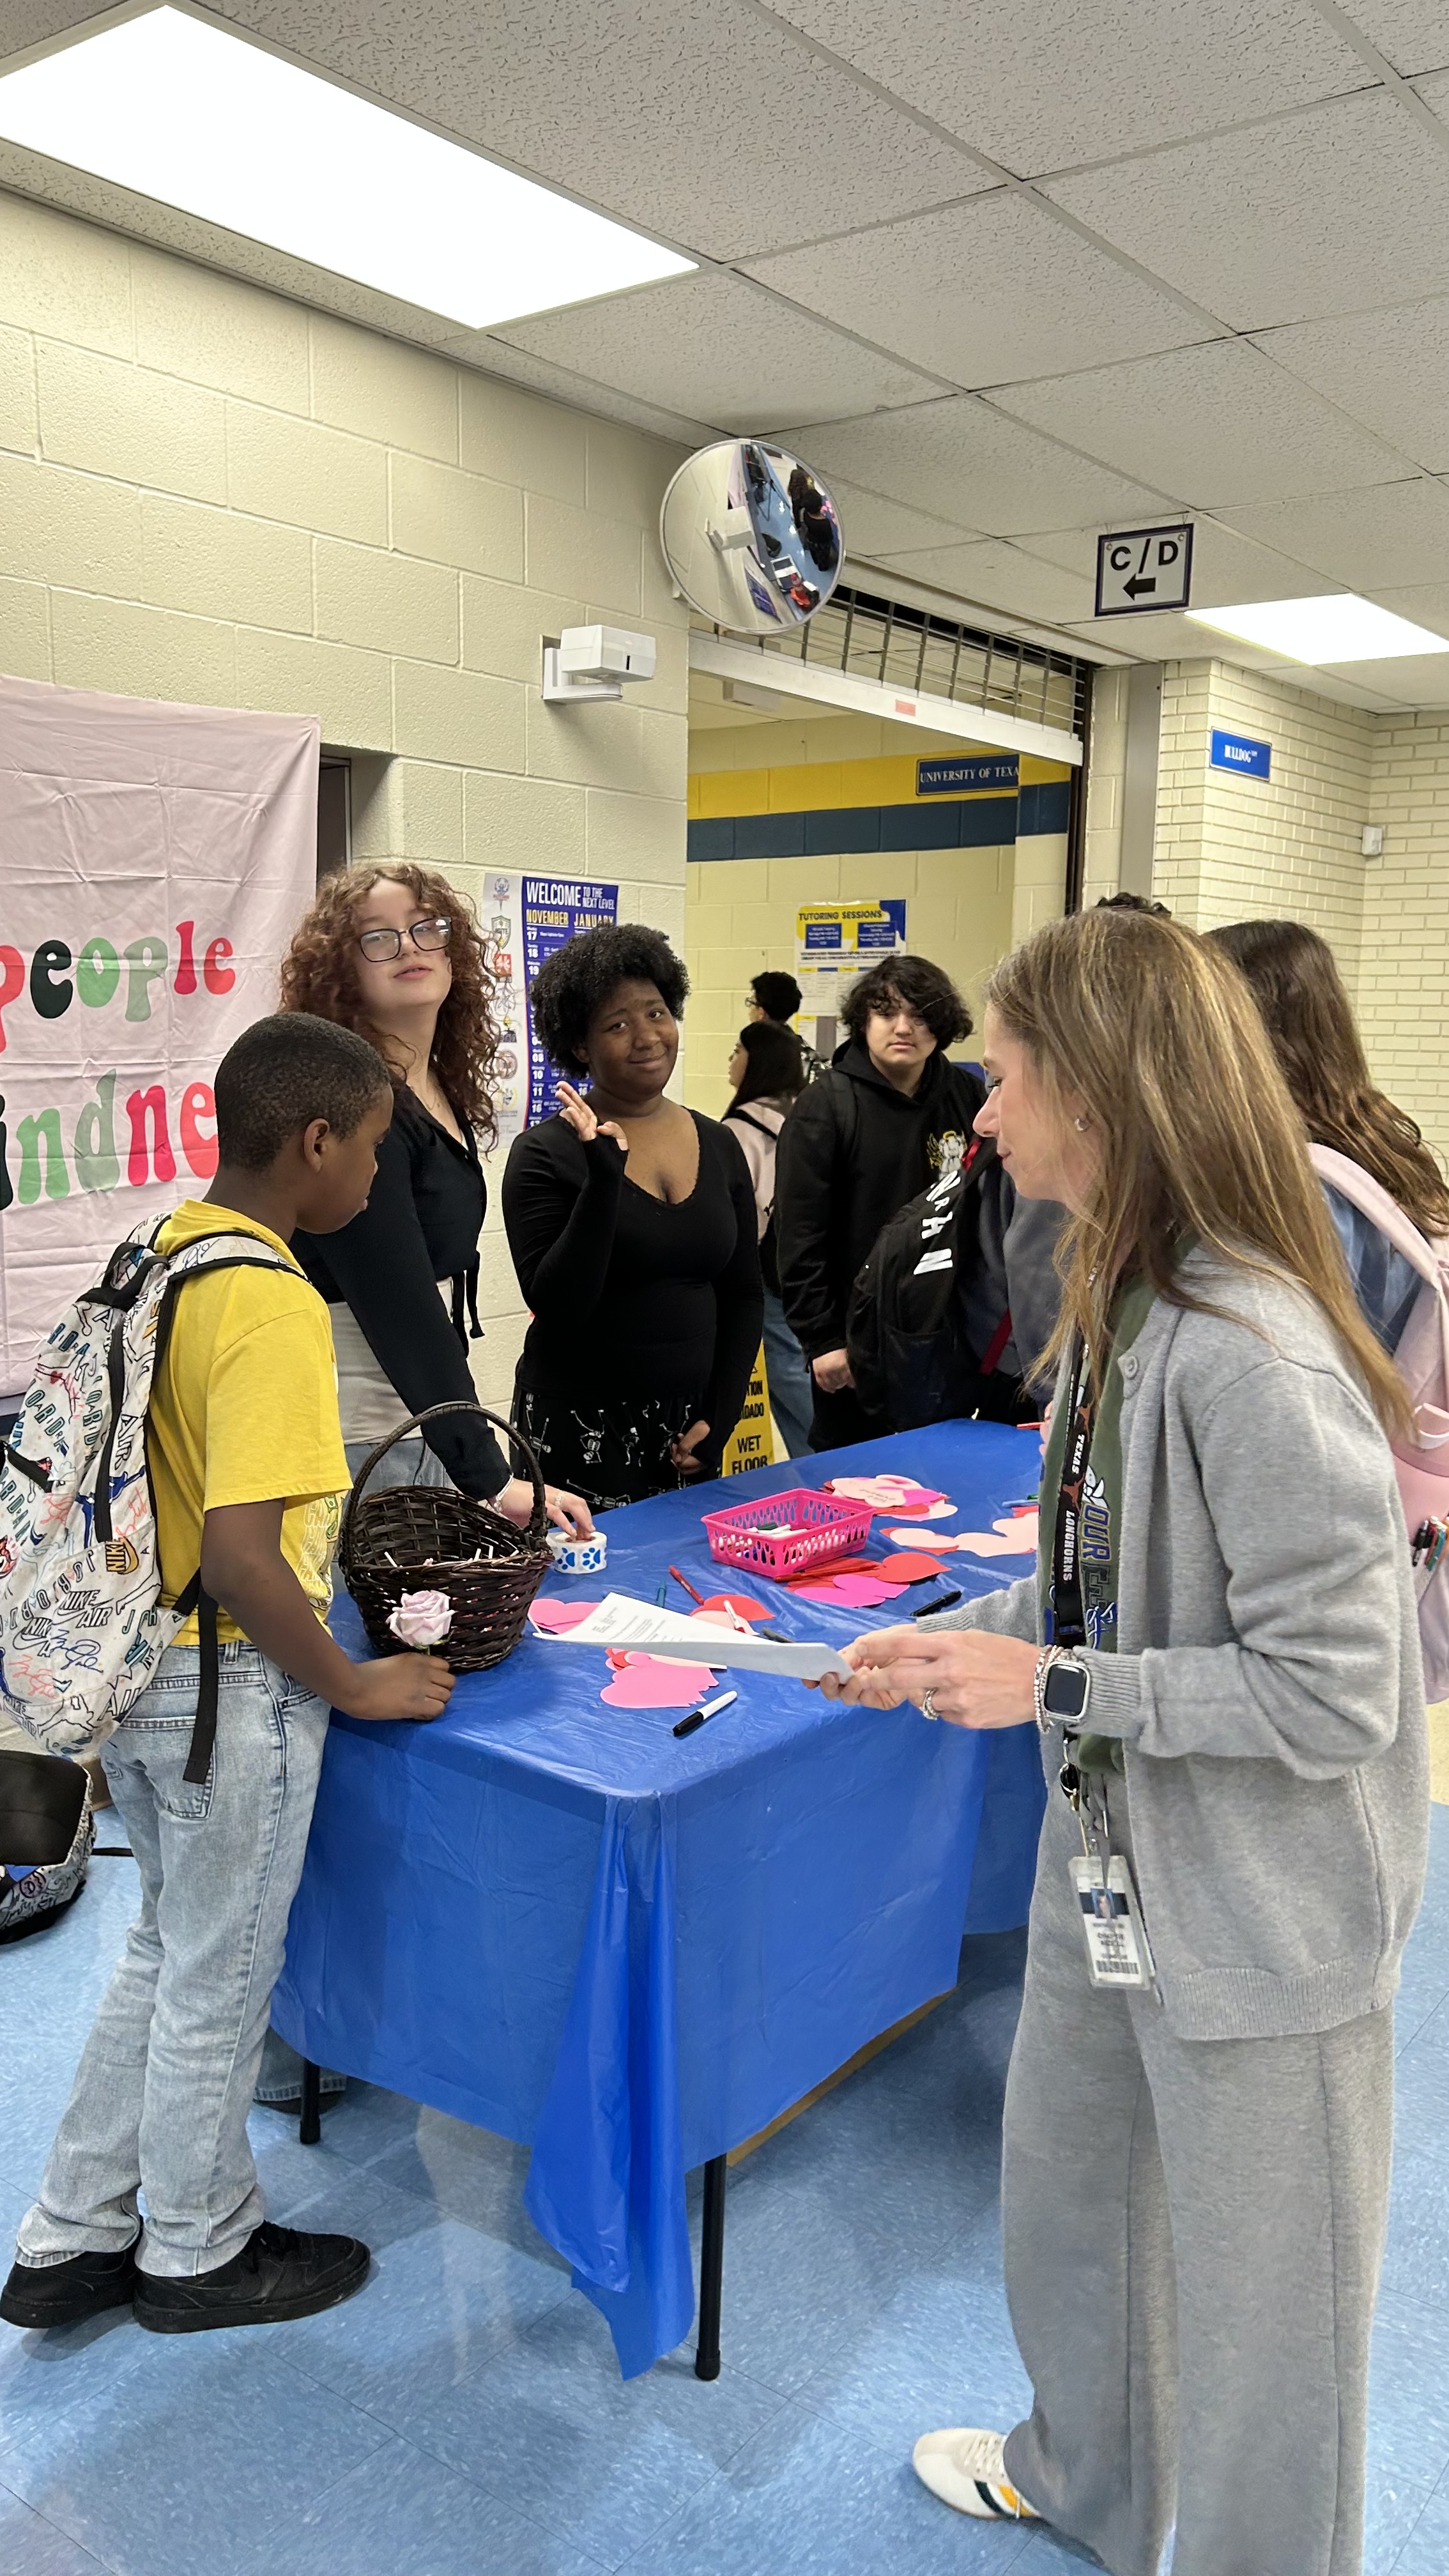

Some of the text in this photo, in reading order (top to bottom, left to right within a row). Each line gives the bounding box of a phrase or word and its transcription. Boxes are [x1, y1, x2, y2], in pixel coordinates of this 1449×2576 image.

[920, 769, 976, 783] UNIVERSITY
[978, 767, 992, 779] OF
[526, 881, 603, 907] WELCOME TO THE
[582, 897, 615, 910] NEXT LEVEL
[526, 908, 569, 926] NOVEMBER
[799, 910, 882, 921] TUTORING SESSIONS
[526, 931, 537, 940] 17
[527, 948, 539, 958] 18
[528, 965, 540, 976] 19
[532, 1070, 544, 1080] 10
[533, 1087, 542, 1097] 11
[737, 1434, 761, 1453] WET
[1072, 1434, 1085, 1474] TEXAS
[732, 1455, 768, 1475] FLOOR
[1080, 1503, 1112, 1562] OUR
[1063, 1510, 1076, 1581] LONGHORNS
[59, 1589, 101, 1611] NIKE
[75, 1607, 113, 1629] AIR
